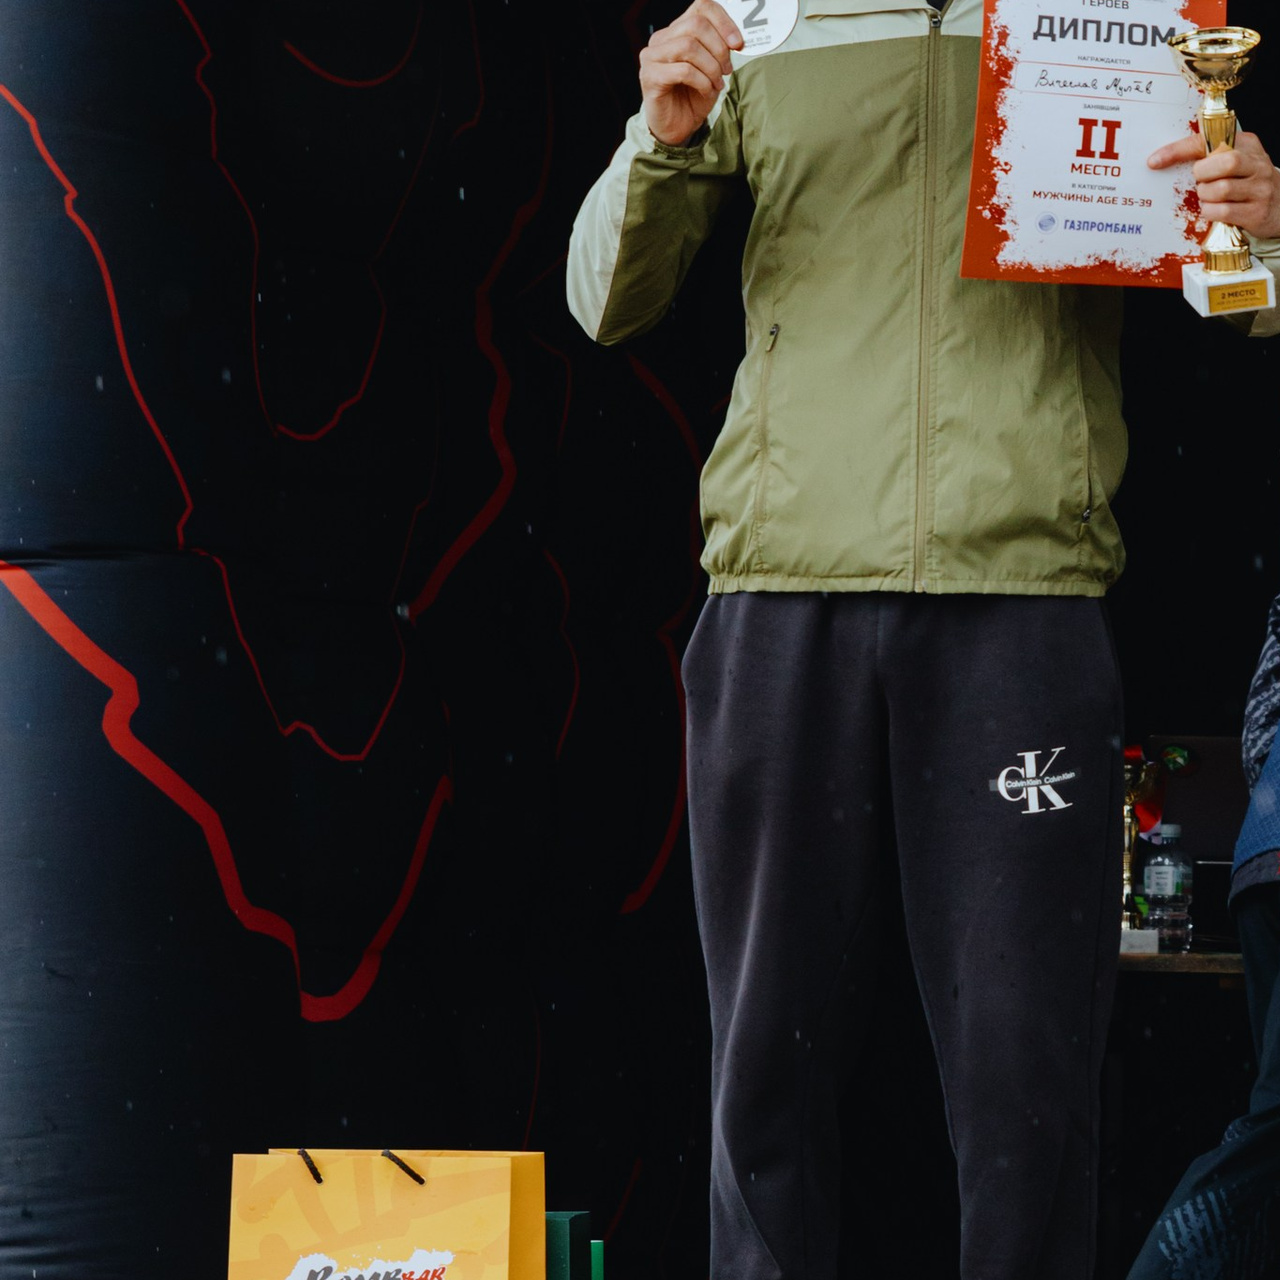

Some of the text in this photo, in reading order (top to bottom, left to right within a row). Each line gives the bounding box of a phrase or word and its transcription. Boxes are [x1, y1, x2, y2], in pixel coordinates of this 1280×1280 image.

[1032, 14, 1177, 48] ДИПЛОМ
[1075, 117, 1122, 161] II
[1070, 162, 1122, 177] МЕСТО
[1032, 190, 1153, 208] МУЖЧИНЫ AGE 35-39
[1063, 219, 1143, 235] ГАЗПРОМБАНК
[1227, 288, 1256, 299] МЕСТО
